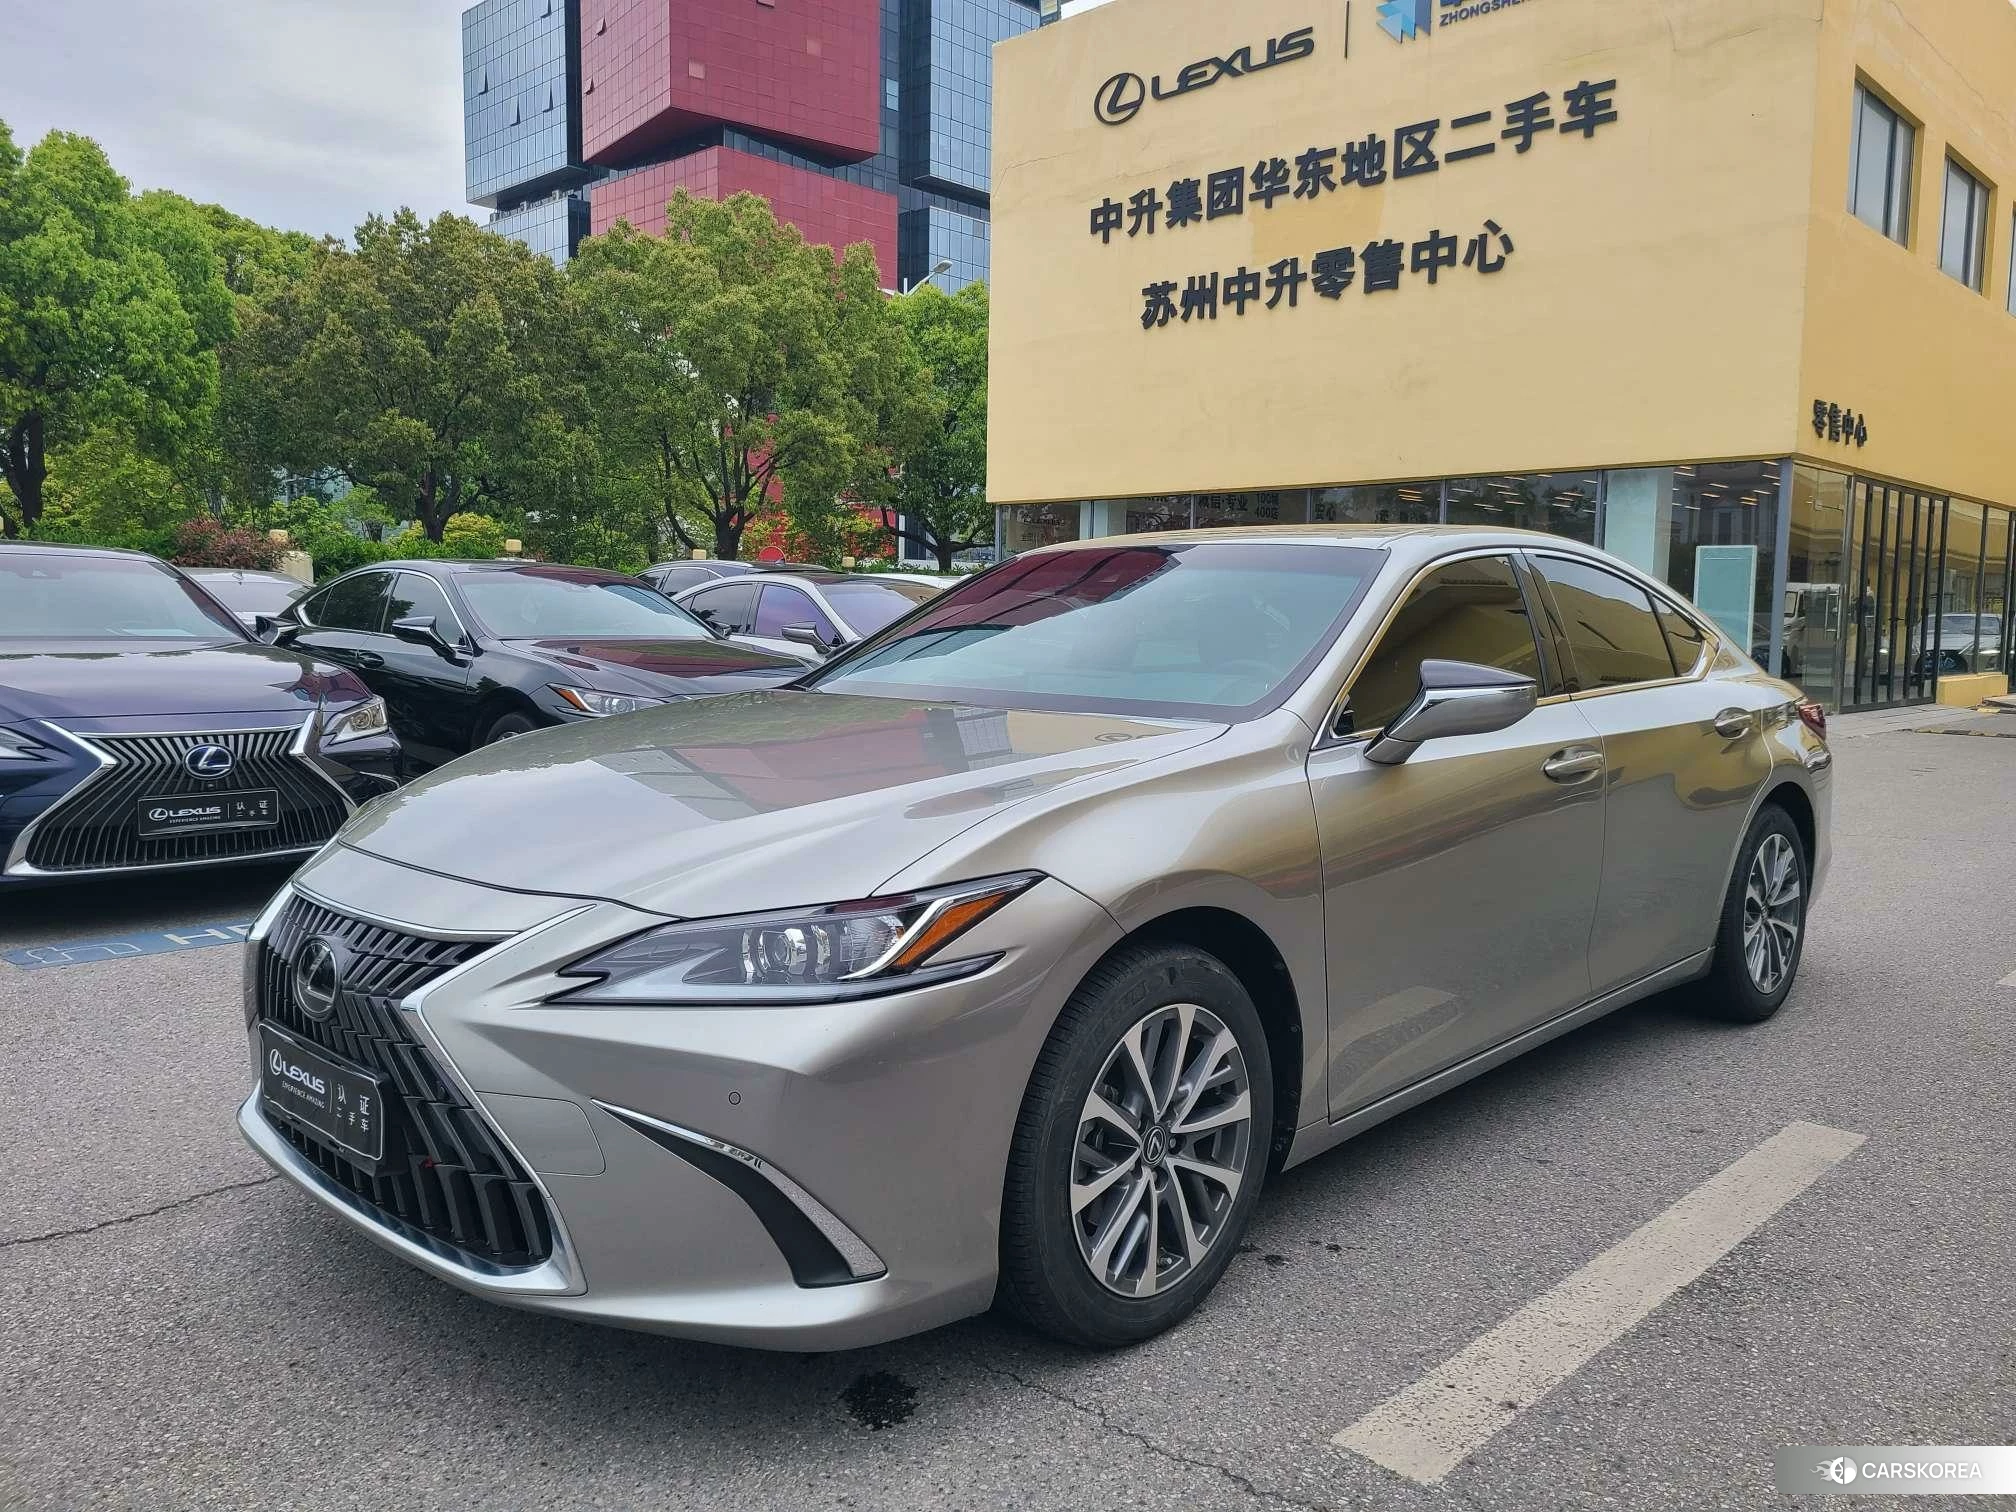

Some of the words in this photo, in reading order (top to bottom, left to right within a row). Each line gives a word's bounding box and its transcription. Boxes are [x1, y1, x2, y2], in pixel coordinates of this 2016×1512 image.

[1150, 26, 1315, 101] LEXUS
[1090, 79, 1617, 244] 中升集团华东地区二手车
[1140, 219, 1515, 330] 苏州中升零售中心
[1812, 399, 1868, 448] 零售中心
[169, 806, 221, 817] LEXUS
[282, 1060, 326, 1095] LEXUS
